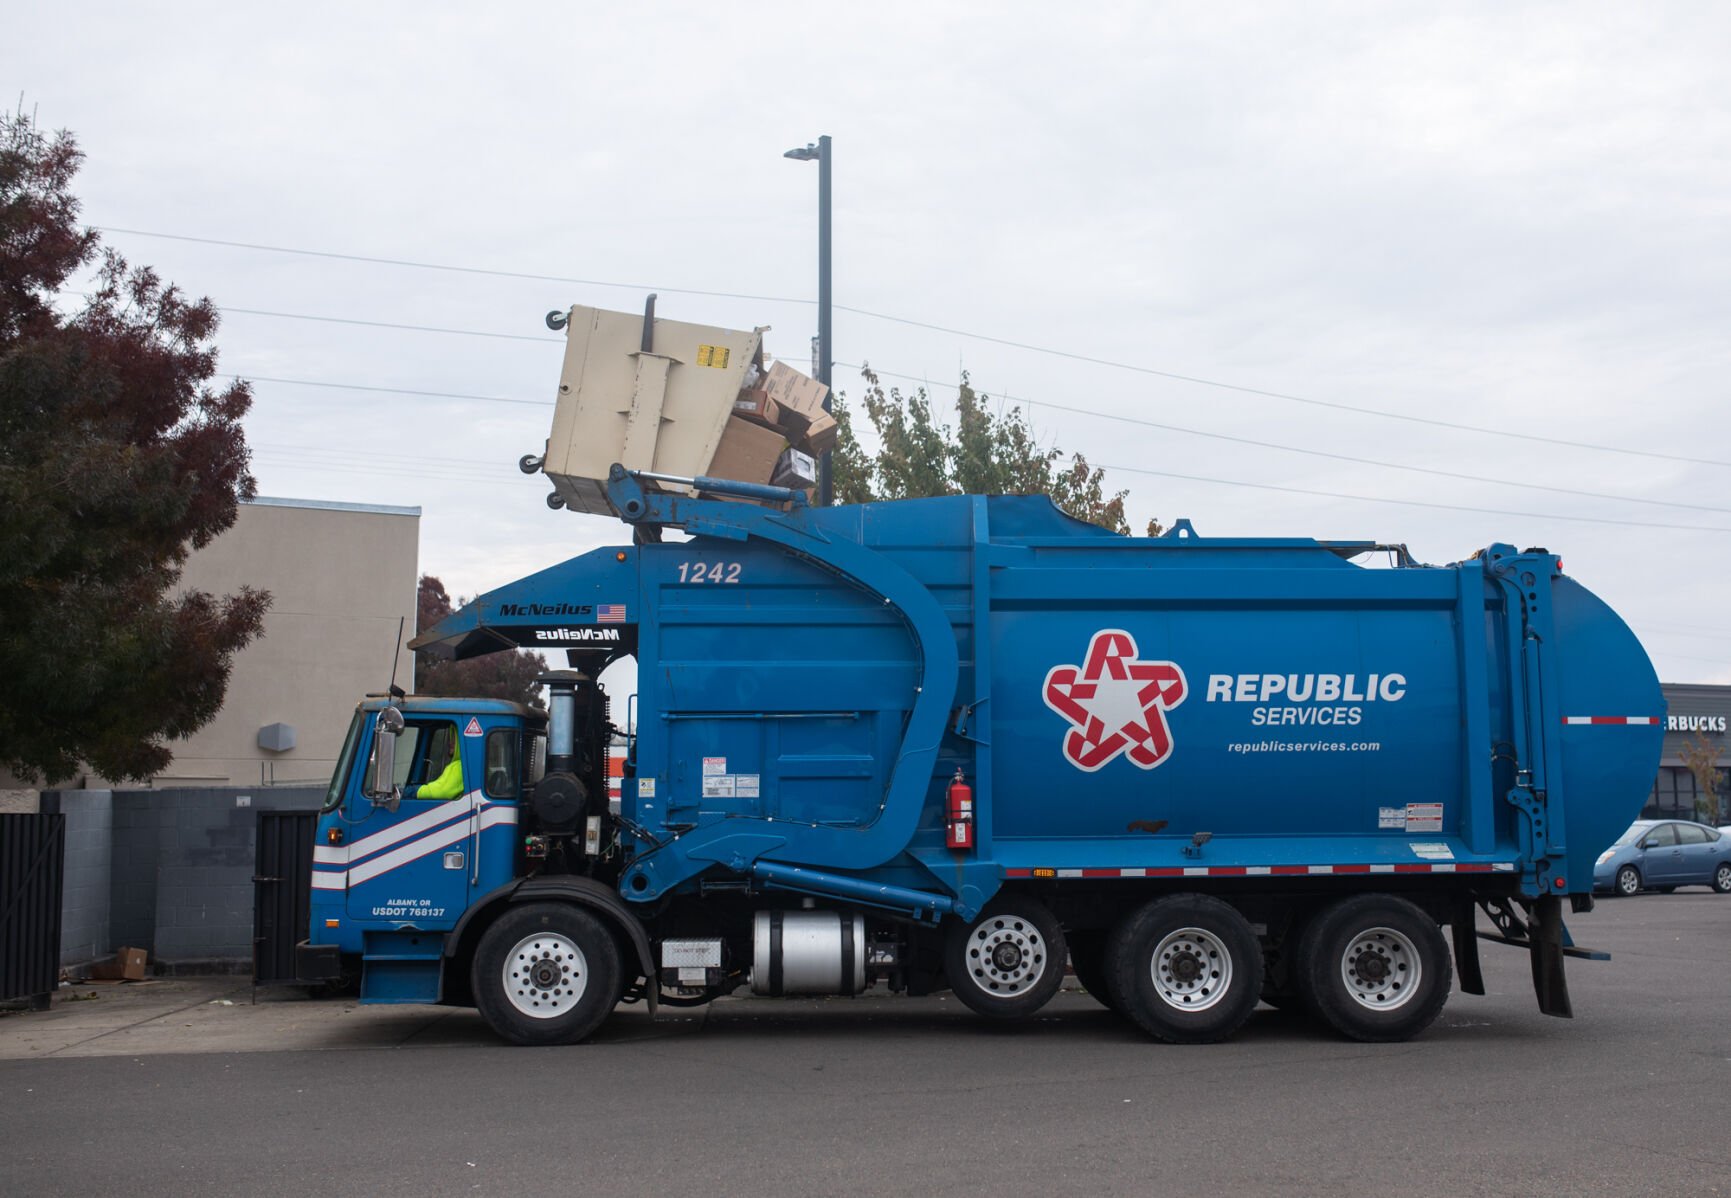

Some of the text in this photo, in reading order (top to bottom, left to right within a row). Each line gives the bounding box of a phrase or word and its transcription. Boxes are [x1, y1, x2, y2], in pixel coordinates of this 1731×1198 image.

[678, 562, 742, 583] 1242
[500, 603, 592, 617] McNeilus
[1206, 673, 1407, 702] REPUBLIC
[1251, 707, 1362, 726] SERVICES
[1228, 741, 1380, 754] republicservices.com
[387, 899, 418, 907] ALBANY,
[372, 907, 445, 917] USDOT 768137
